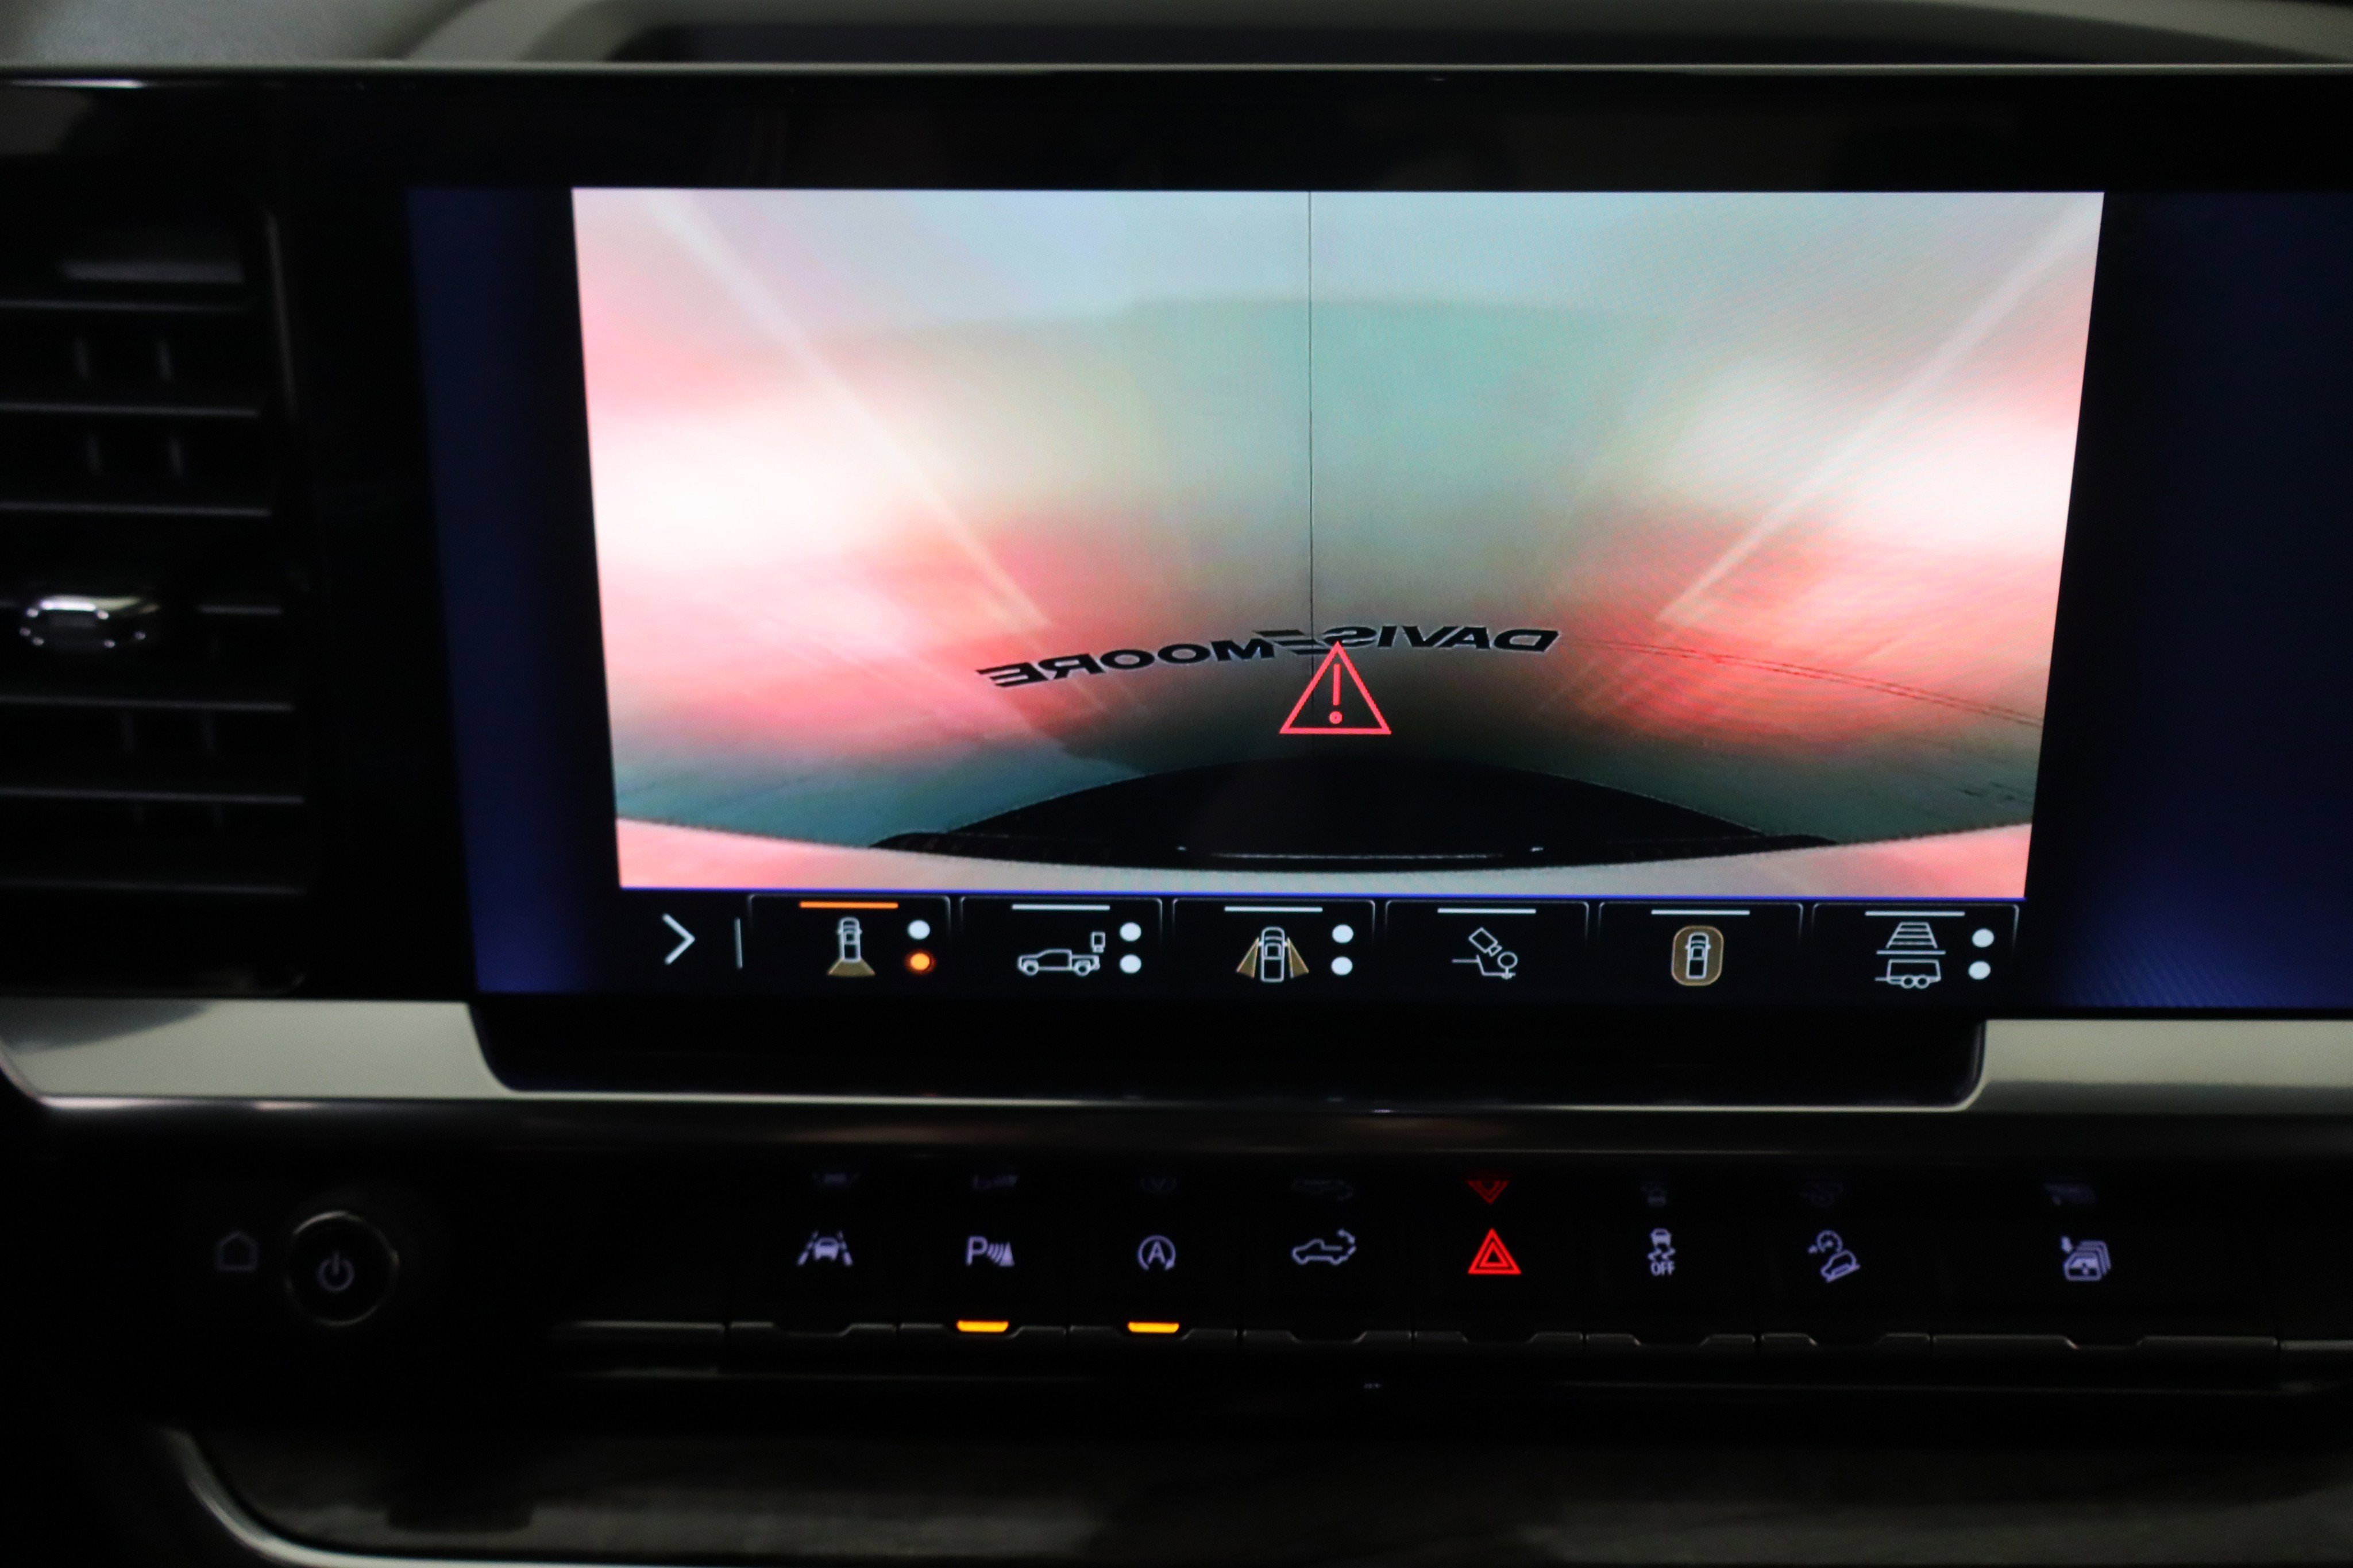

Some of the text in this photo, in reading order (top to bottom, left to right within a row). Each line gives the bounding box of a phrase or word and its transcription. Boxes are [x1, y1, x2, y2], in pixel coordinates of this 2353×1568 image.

[966, 1235, 988, 1265] P
[1148, 1241, 1166, 1264] A
[1650, 1261, 1675, 1276] OFF
